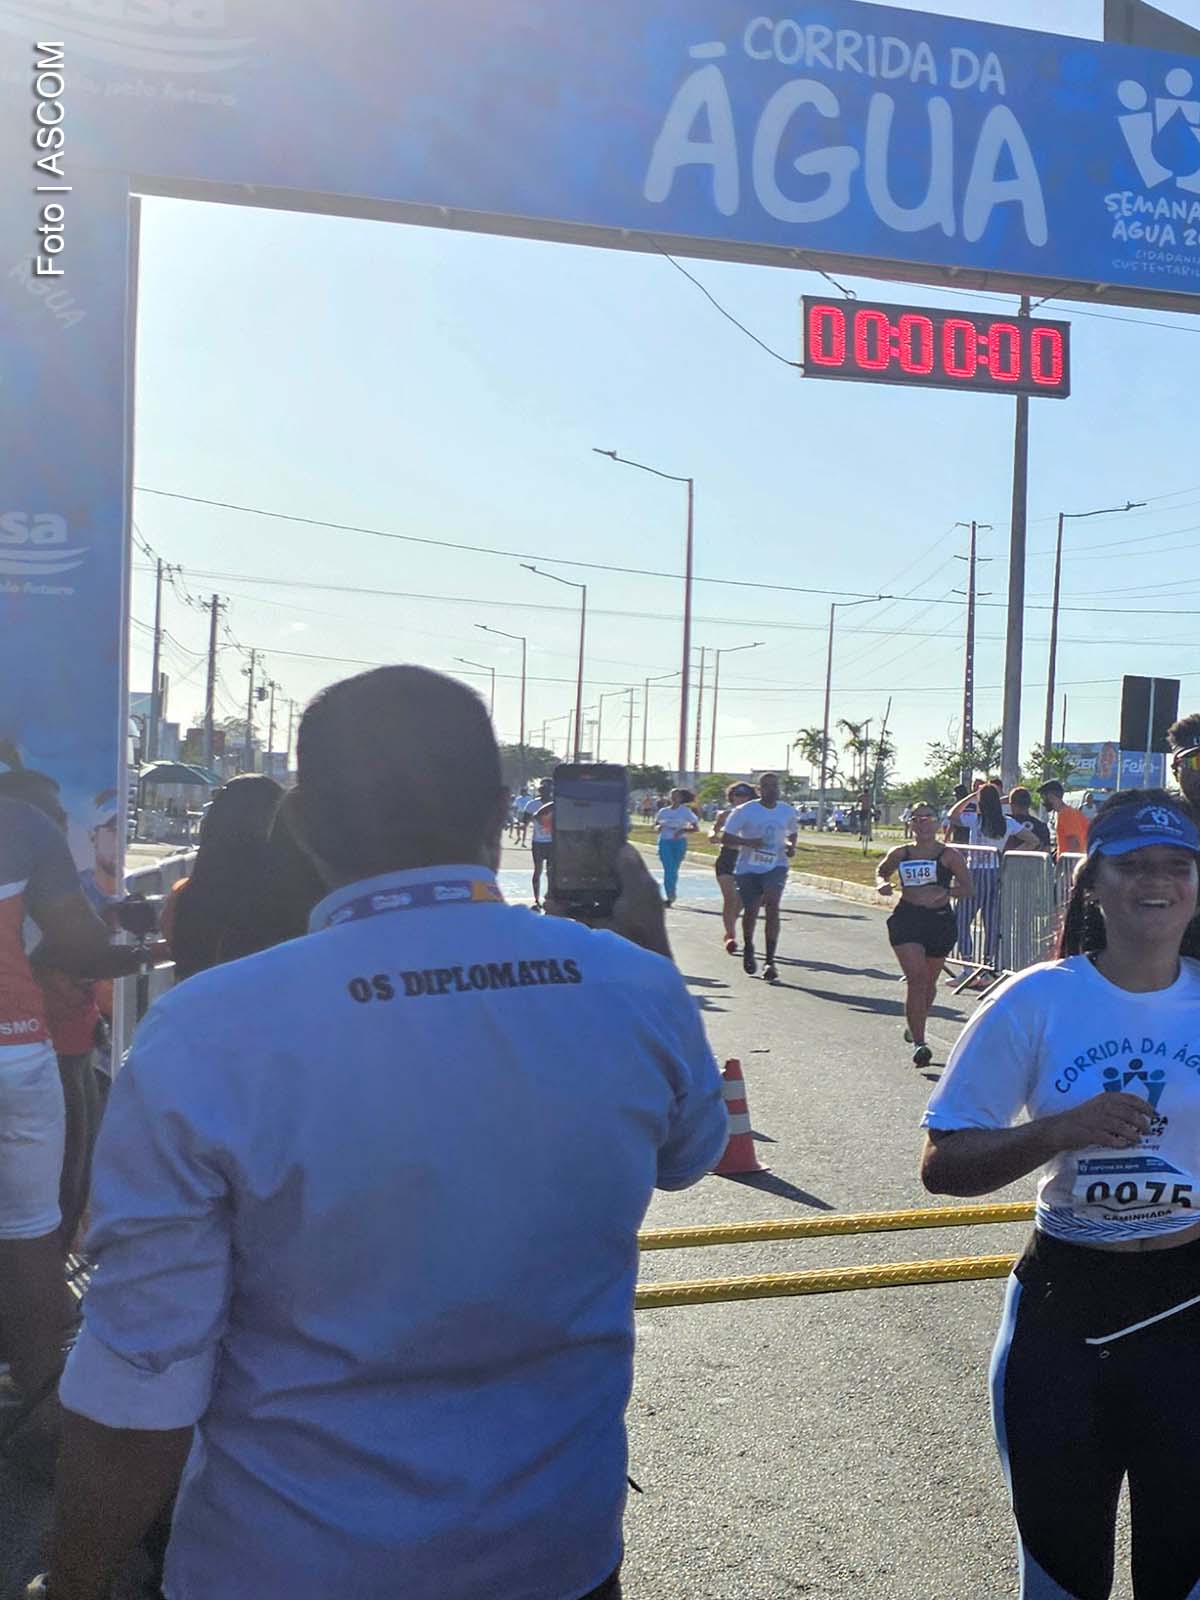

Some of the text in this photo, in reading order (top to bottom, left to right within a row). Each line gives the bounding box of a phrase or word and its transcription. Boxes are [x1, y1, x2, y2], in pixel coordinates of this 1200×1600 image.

[743, 15, 1006, 96] CORRIDA DA
[643, 41, 1049, 248] ÁGUA
[1112, 212, 1176, 247] ÁGUA
[809, 304, 1064, 386] 00:00:00
[905, 867, 930, 879] 5148
[349, 958, 583, 1003] OS DIPLOMATAS
[1055, 1038, 1133, 1095] CORRIDA
[1141, 1038, 1167, 1057] DA
[1150, 1116, 1169, 1126] DA
[1103, 1209, 1173, 1222] CAMINHADA
